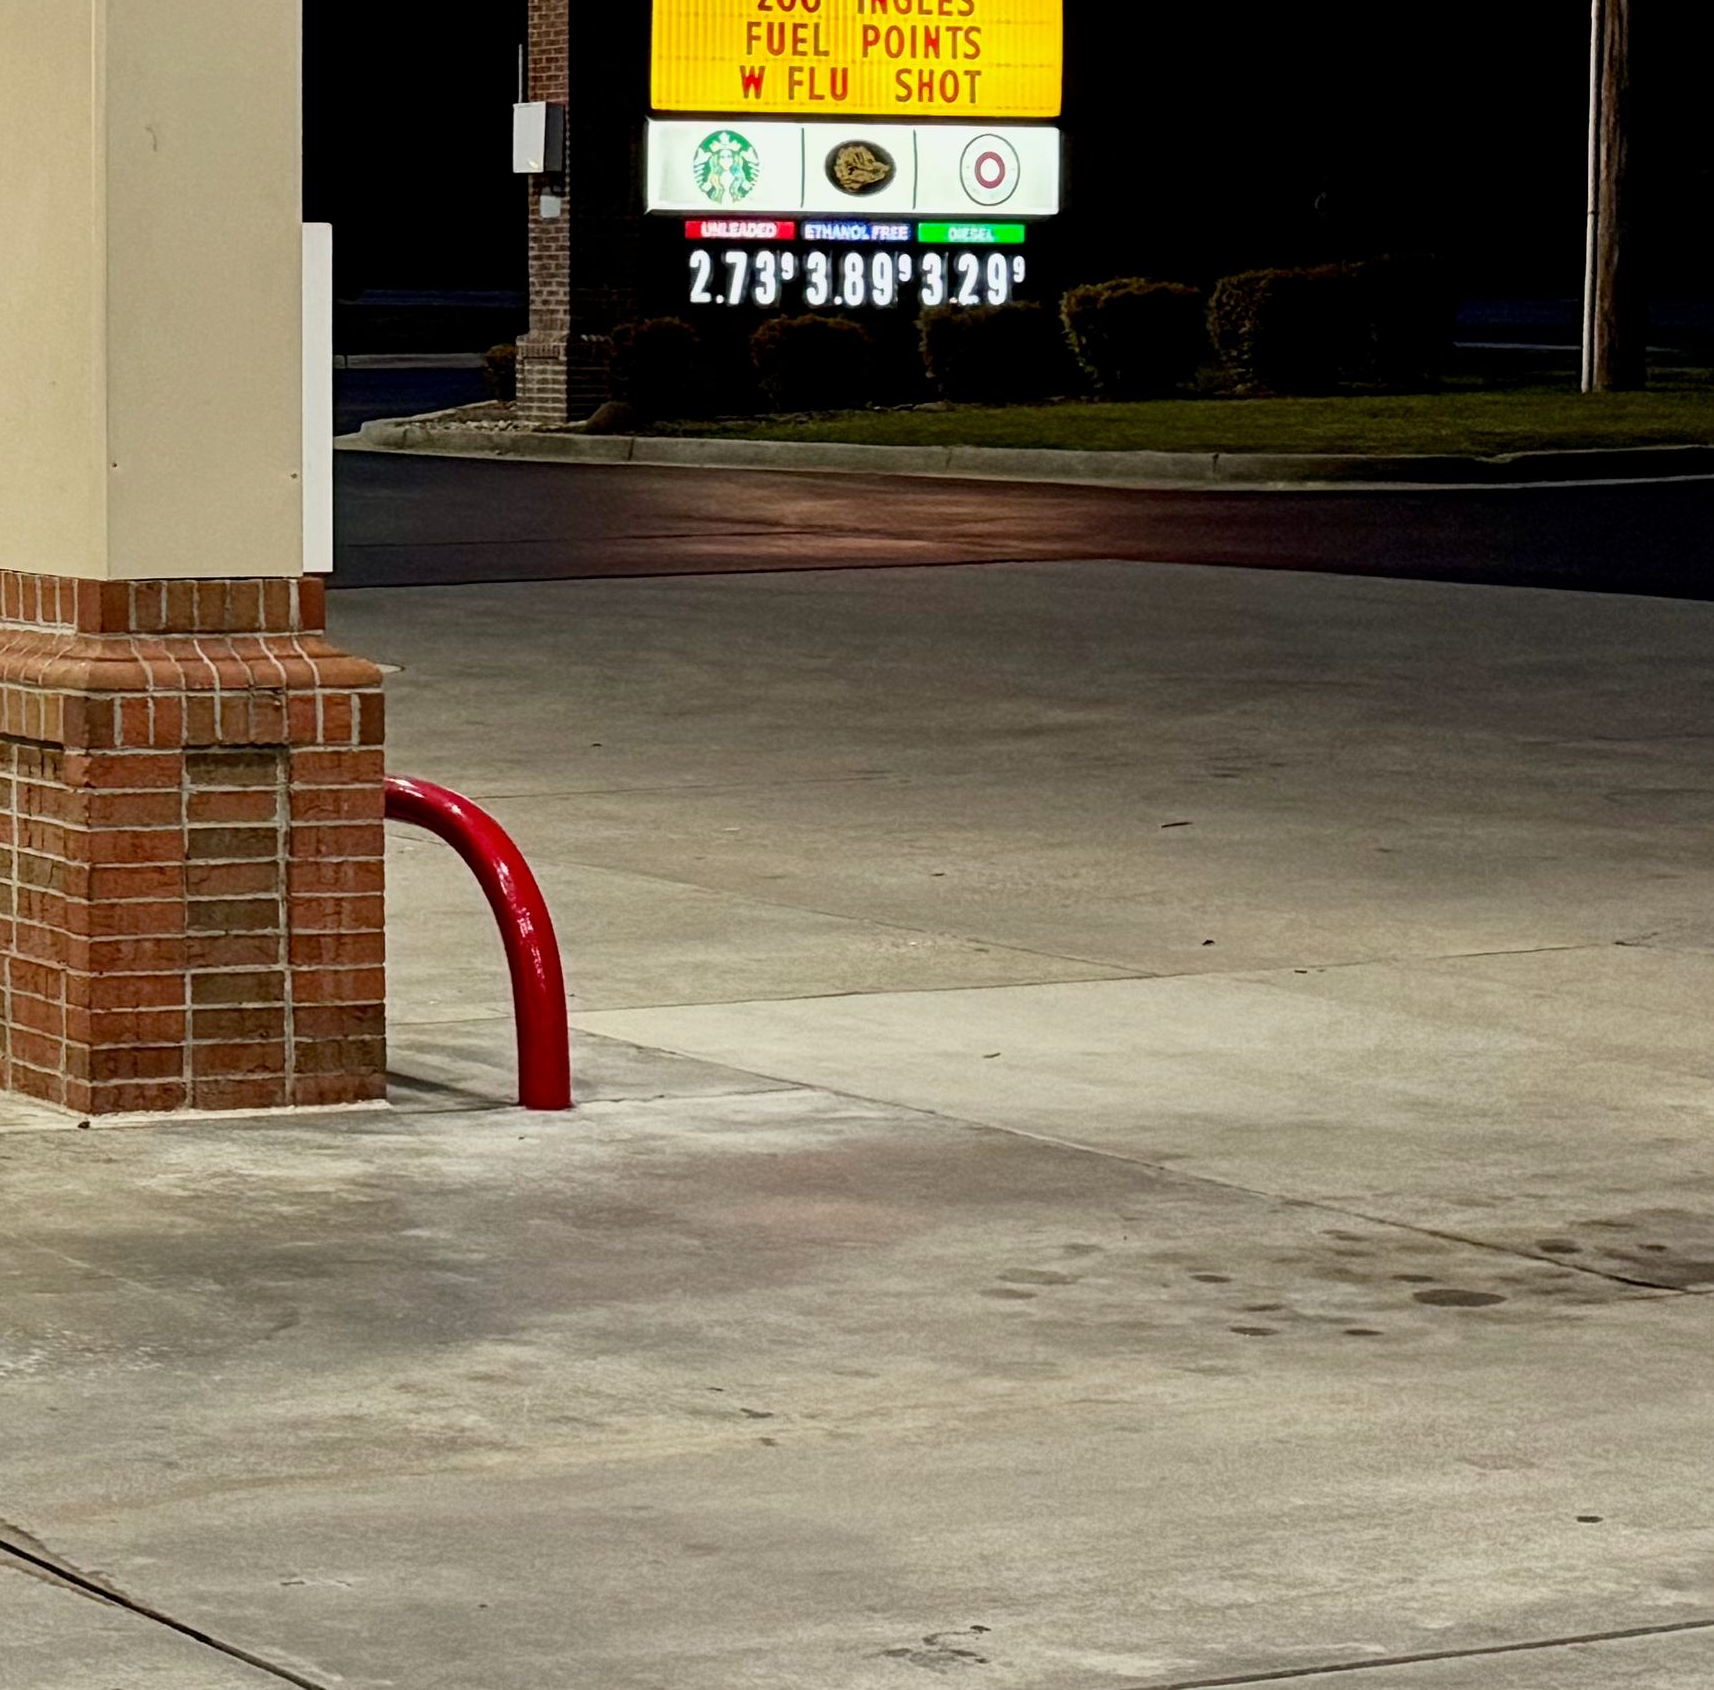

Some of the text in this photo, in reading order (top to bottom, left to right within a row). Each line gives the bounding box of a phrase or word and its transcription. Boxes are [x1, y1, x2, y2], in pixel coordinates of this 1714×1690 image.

[746, 21, 982, 61] FUEL POINTS
[739, 65, 982, 104] W FLU SHOT
[701, 222, 778, 239] UNLEADED
[804, 224, 909, 241] ETHANOL FREE
[947, 227, 996, 242] DIESEL
